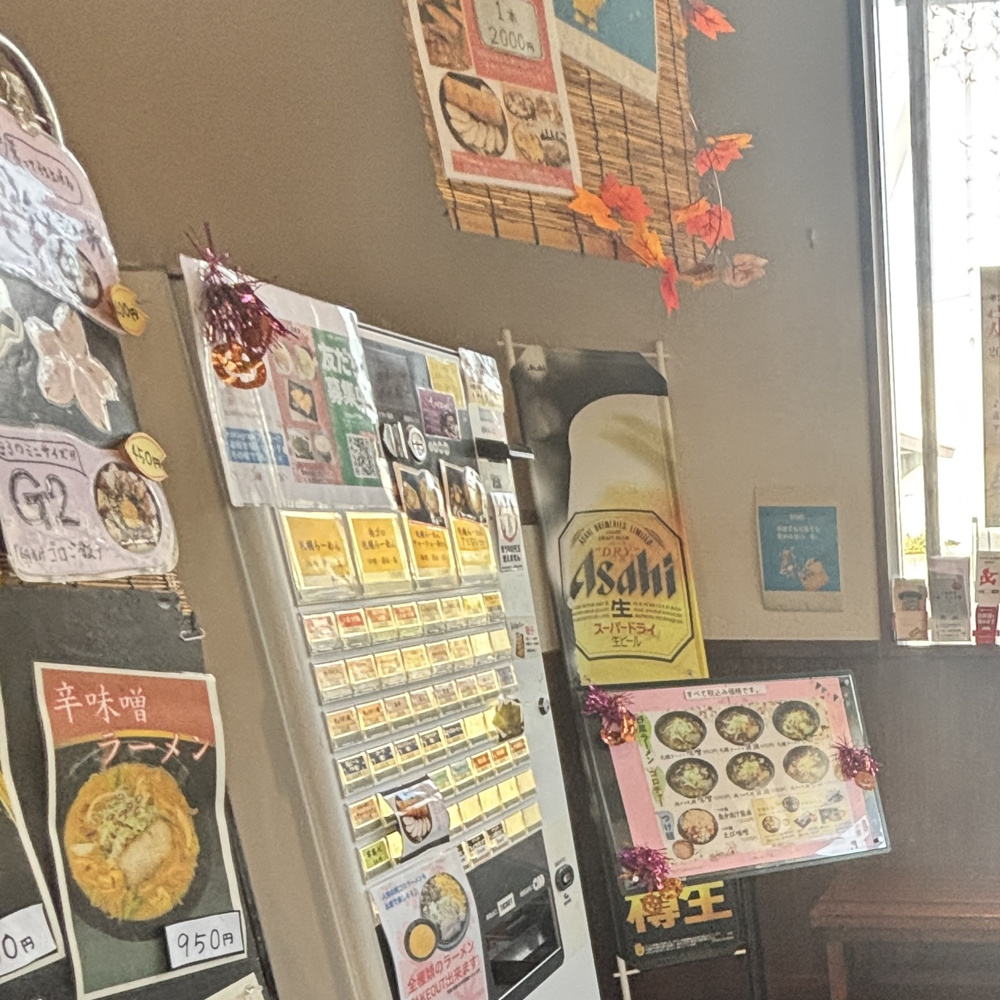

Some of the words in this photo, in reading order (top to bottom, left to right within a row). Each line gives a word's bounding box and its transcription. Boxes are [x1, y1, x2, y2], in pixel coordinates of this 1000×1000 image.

[488, 26, 535, 53] 2000円
[569, 548, 677, 600] Asahi
[611, 598, 633, 618] 生
[594, 621, 656, 636] スーパードライ
[611, 635, 642, 648] 生ビール
[53, 680, 148, 724] 辛味噌
[686, 685, 761, 699] すべて税込み価格です。
[97, 732, 212, 768] ラーメン
[177, 928, 235, 957] 950円
[407, 942, 476, 994] 全種類のラーメン
